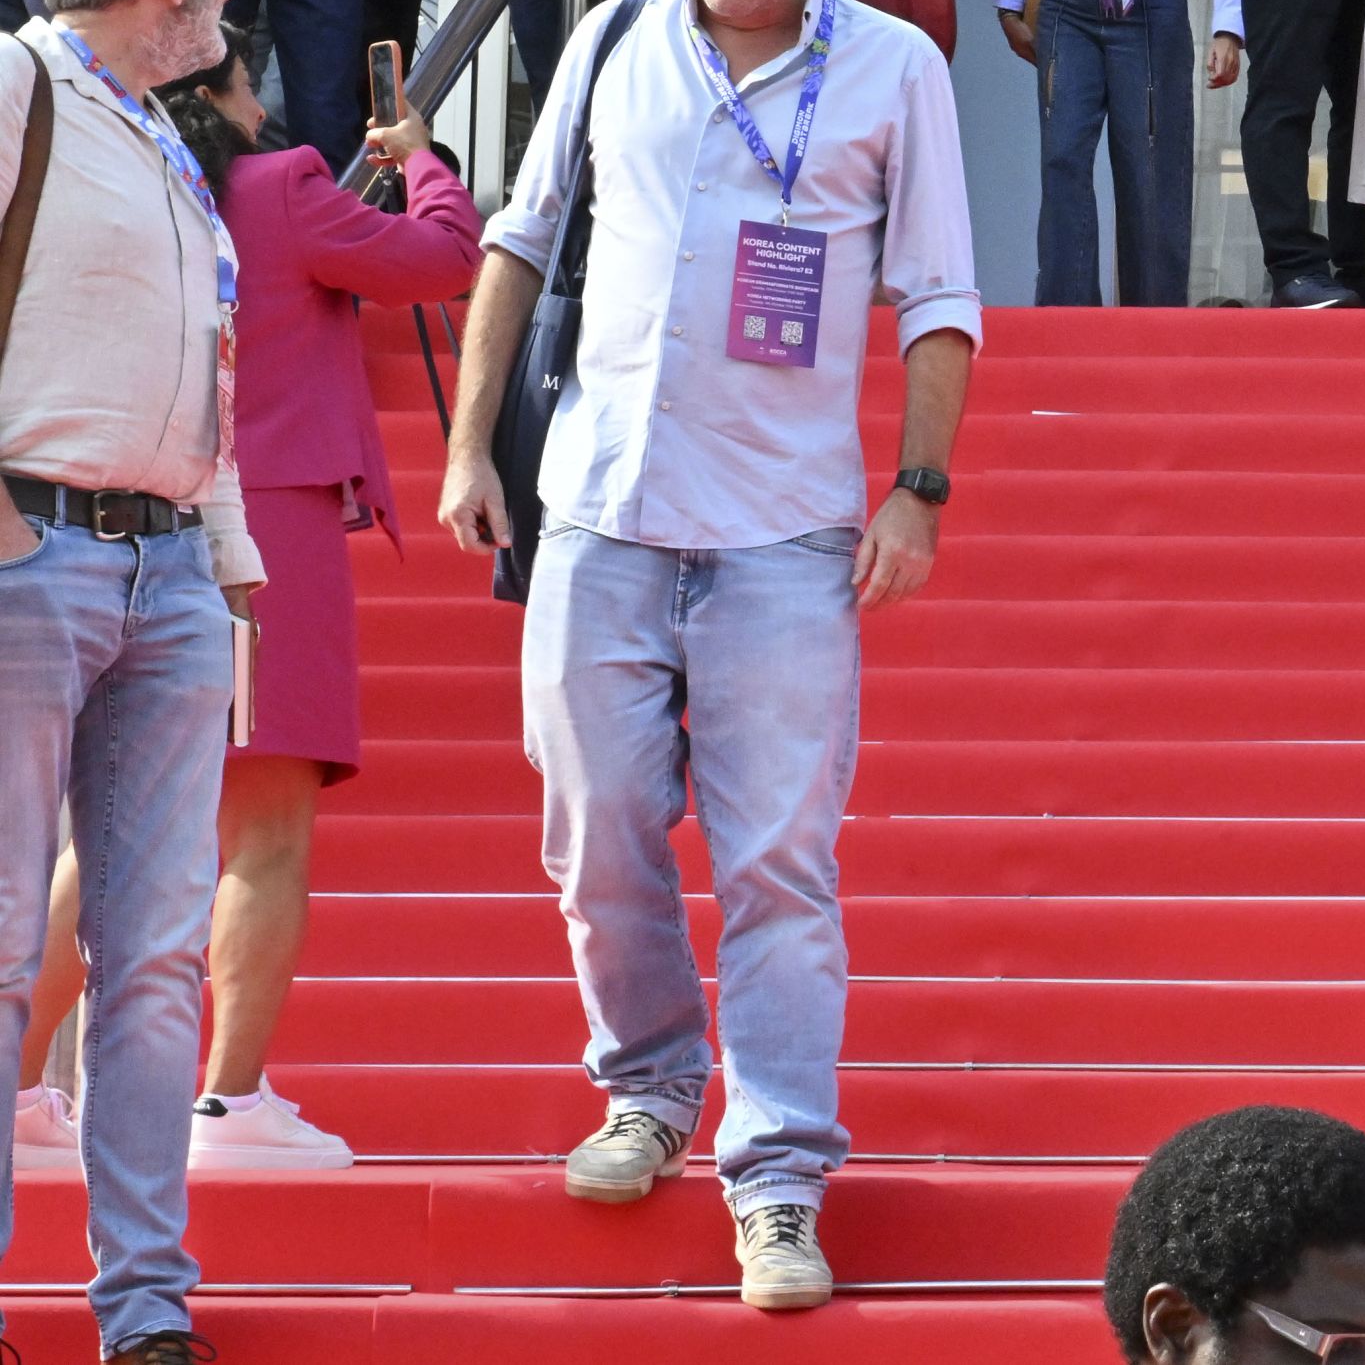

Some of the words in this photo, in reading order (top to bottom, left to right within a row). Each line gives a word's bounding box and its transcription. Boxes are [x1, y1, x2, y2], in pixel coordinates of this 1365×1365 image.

[717, 71, 738, 101] DIGIMON
[792, 109, 806, 146] DIGIMON
[796, 101, 816, 158] BEATBREAK
[743, 237, 774, 249] KOREA
[776, 242, 822, 256] CONTENT
[756, 249, 807, 263] HIGHLIGHT
[747, 260, 767, 269] Stand
